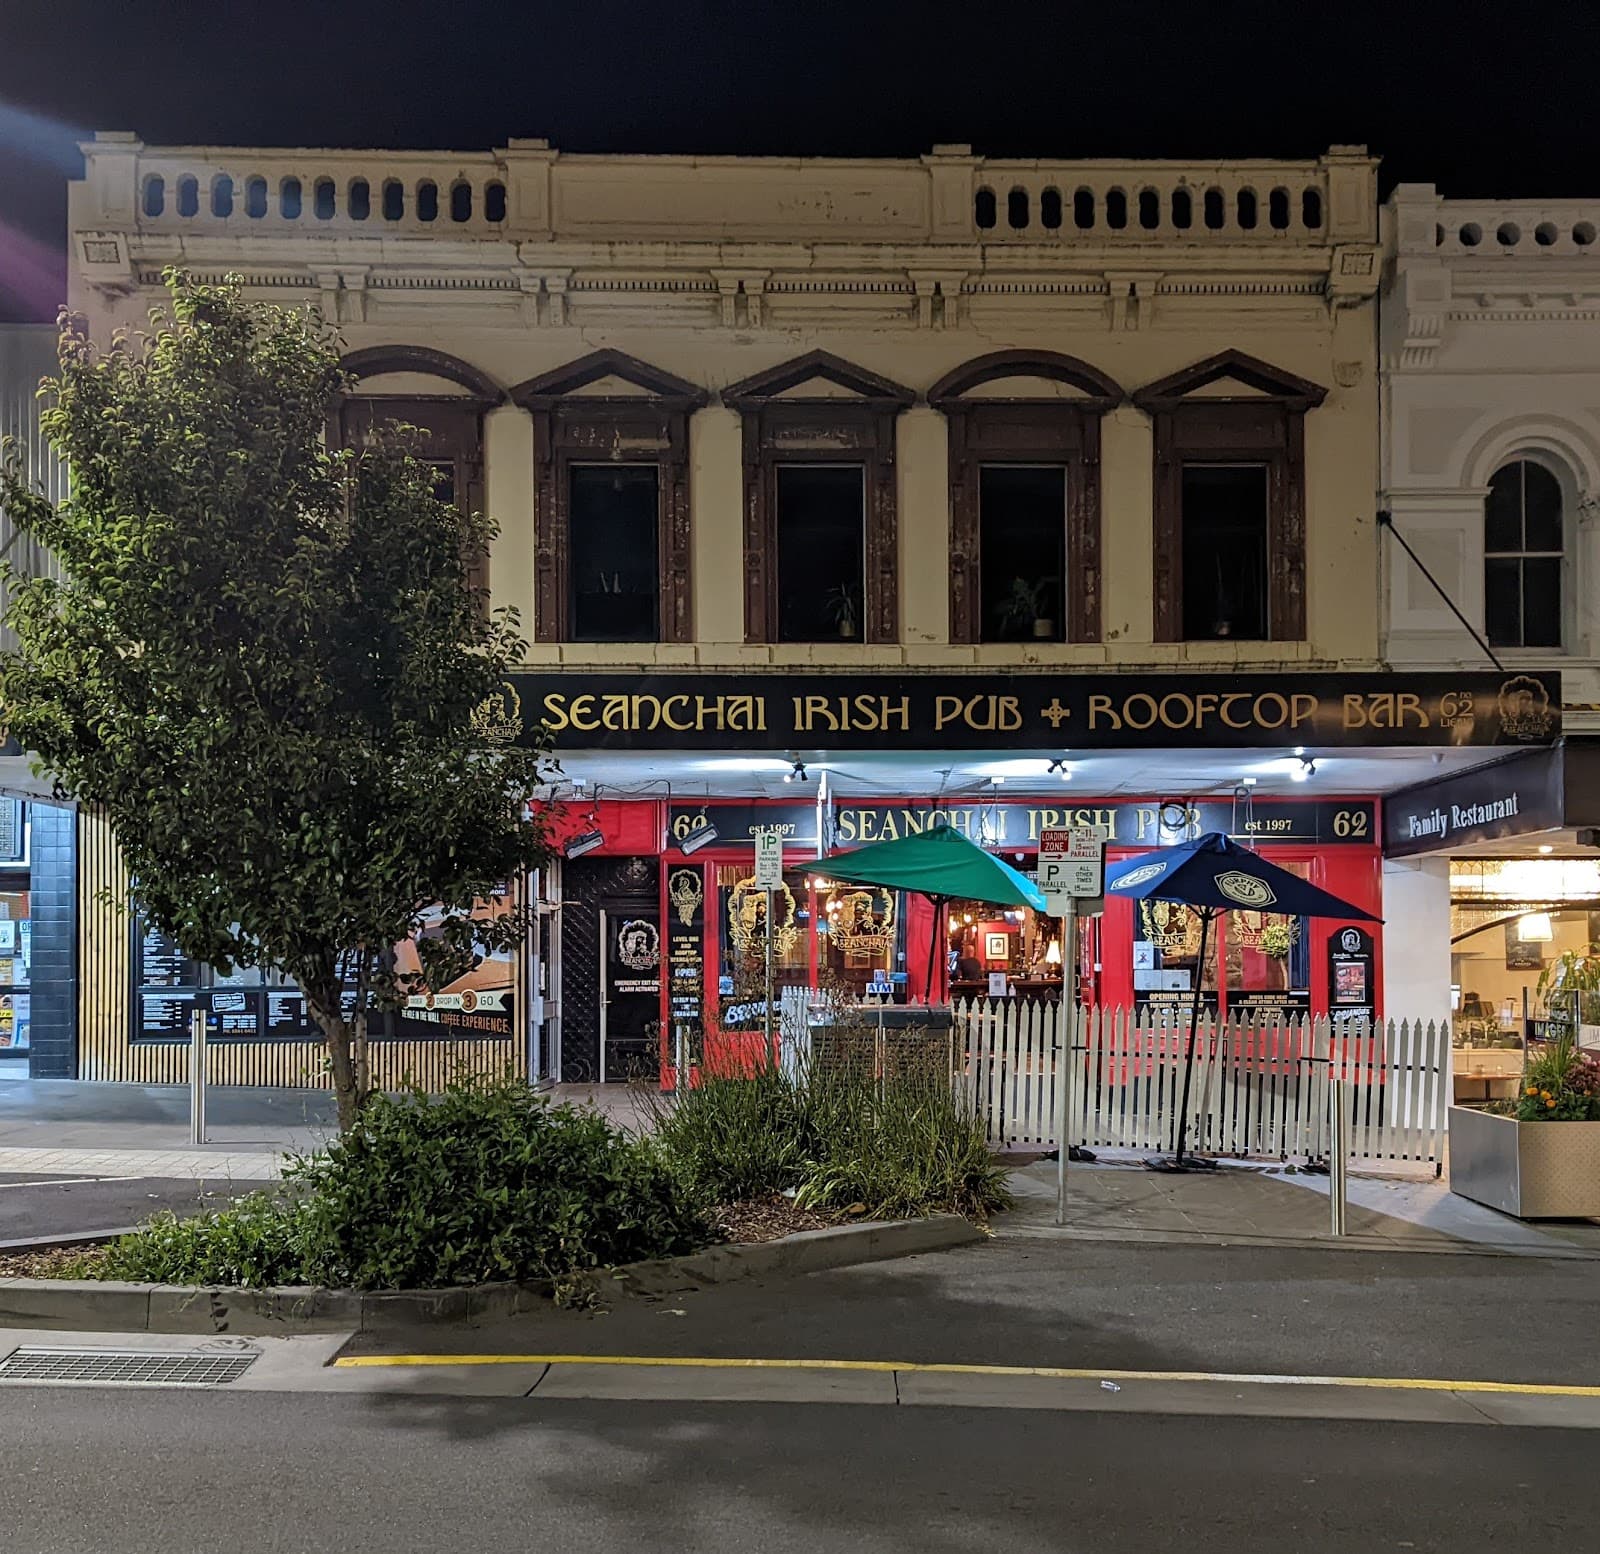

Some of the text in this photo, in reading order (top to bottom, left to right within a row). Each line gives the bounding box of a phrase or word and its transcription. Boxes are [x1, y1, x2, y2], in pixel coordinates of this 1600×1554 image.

[541, 692, 1475, 731] SEANCHAI IRISH PUB ROOFTOP BAR 62
[1408, 791, 1520, 839] Family Restaurant
[748, 823, 796, 835] est 1997
[1027, 809, 1118, 841] IRISH
[1244, 819, 1293, 832] est 1997
[1333, 810, 1368, 838] 62
[761, 834, 777, 850] 1P
[1041, 831, 1069, 842] LOADING
[1044, 842, 1065, 852] ZONE
[1070, 850, 1100, 858] PARALLEL
[1047, 865, 1060, 881] P
[1039, 880, 1068, 889] PARALLEL
[867, 983, 892, 993] ATM
[425, 993, 434, 1005] 2
[436, 996, 452, 1005] DROP
[453, 996, 460, 1005] IN
[464, 994, 472, 1008] 3
[480, 995, 494, 1006] GO
[1149, 992, 1205, 1001] OPENING HOUS
[428, 1010, 441, 1023] WALL
[440, 1012, 461, 1027] COFFEE
[461, 1015, 509, 1034] EXPERIENCE
